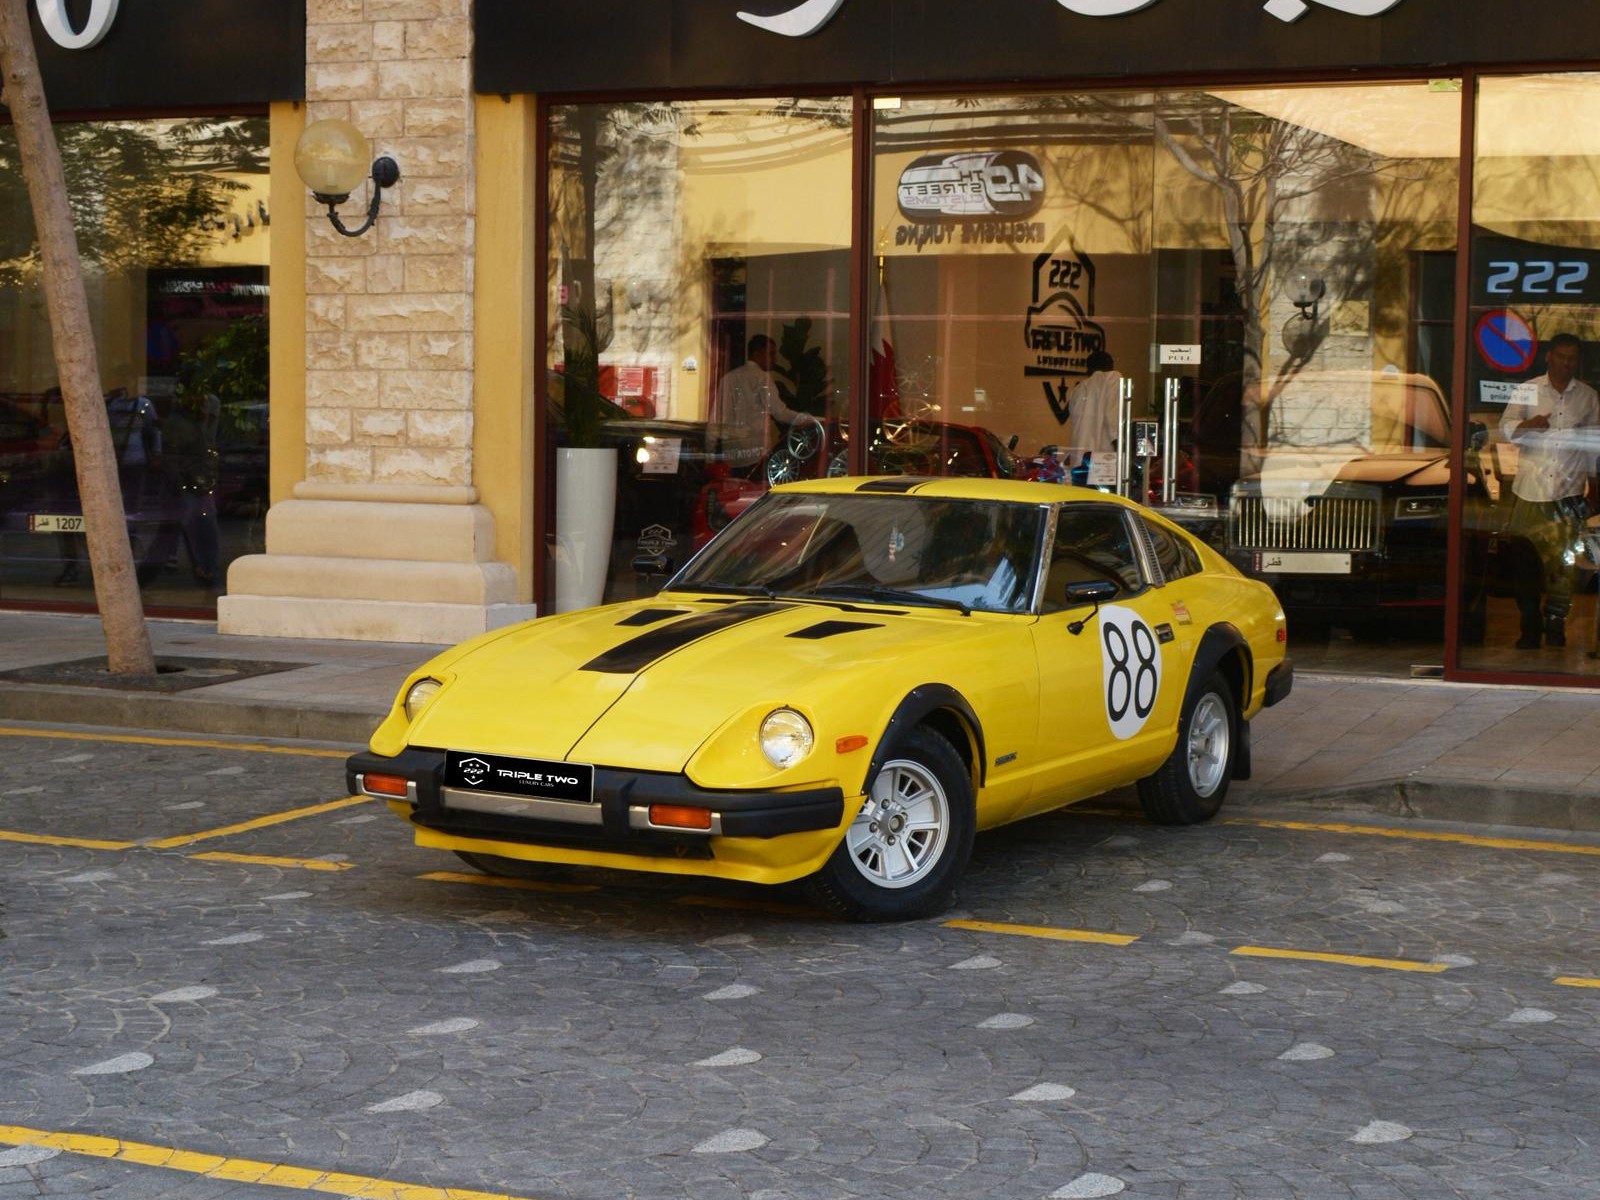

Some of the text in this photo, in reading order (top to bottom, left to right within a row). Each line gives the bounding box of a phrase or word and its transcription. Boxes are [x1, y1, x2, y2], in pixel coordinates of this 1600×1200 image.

[1048, 259, 1081, 291] 222
[1486, 260, 1590, 294] 222
[1070, 356, 1086, 367] CAR
[55, 517, 83, 530] 1207
[1264, 556, 1283, 568] قطر
[1103, 620, 1157, 722] 88
[463, 767, 485, 775] 222
[496, 769, 579, 785] TRIPLE TWO
